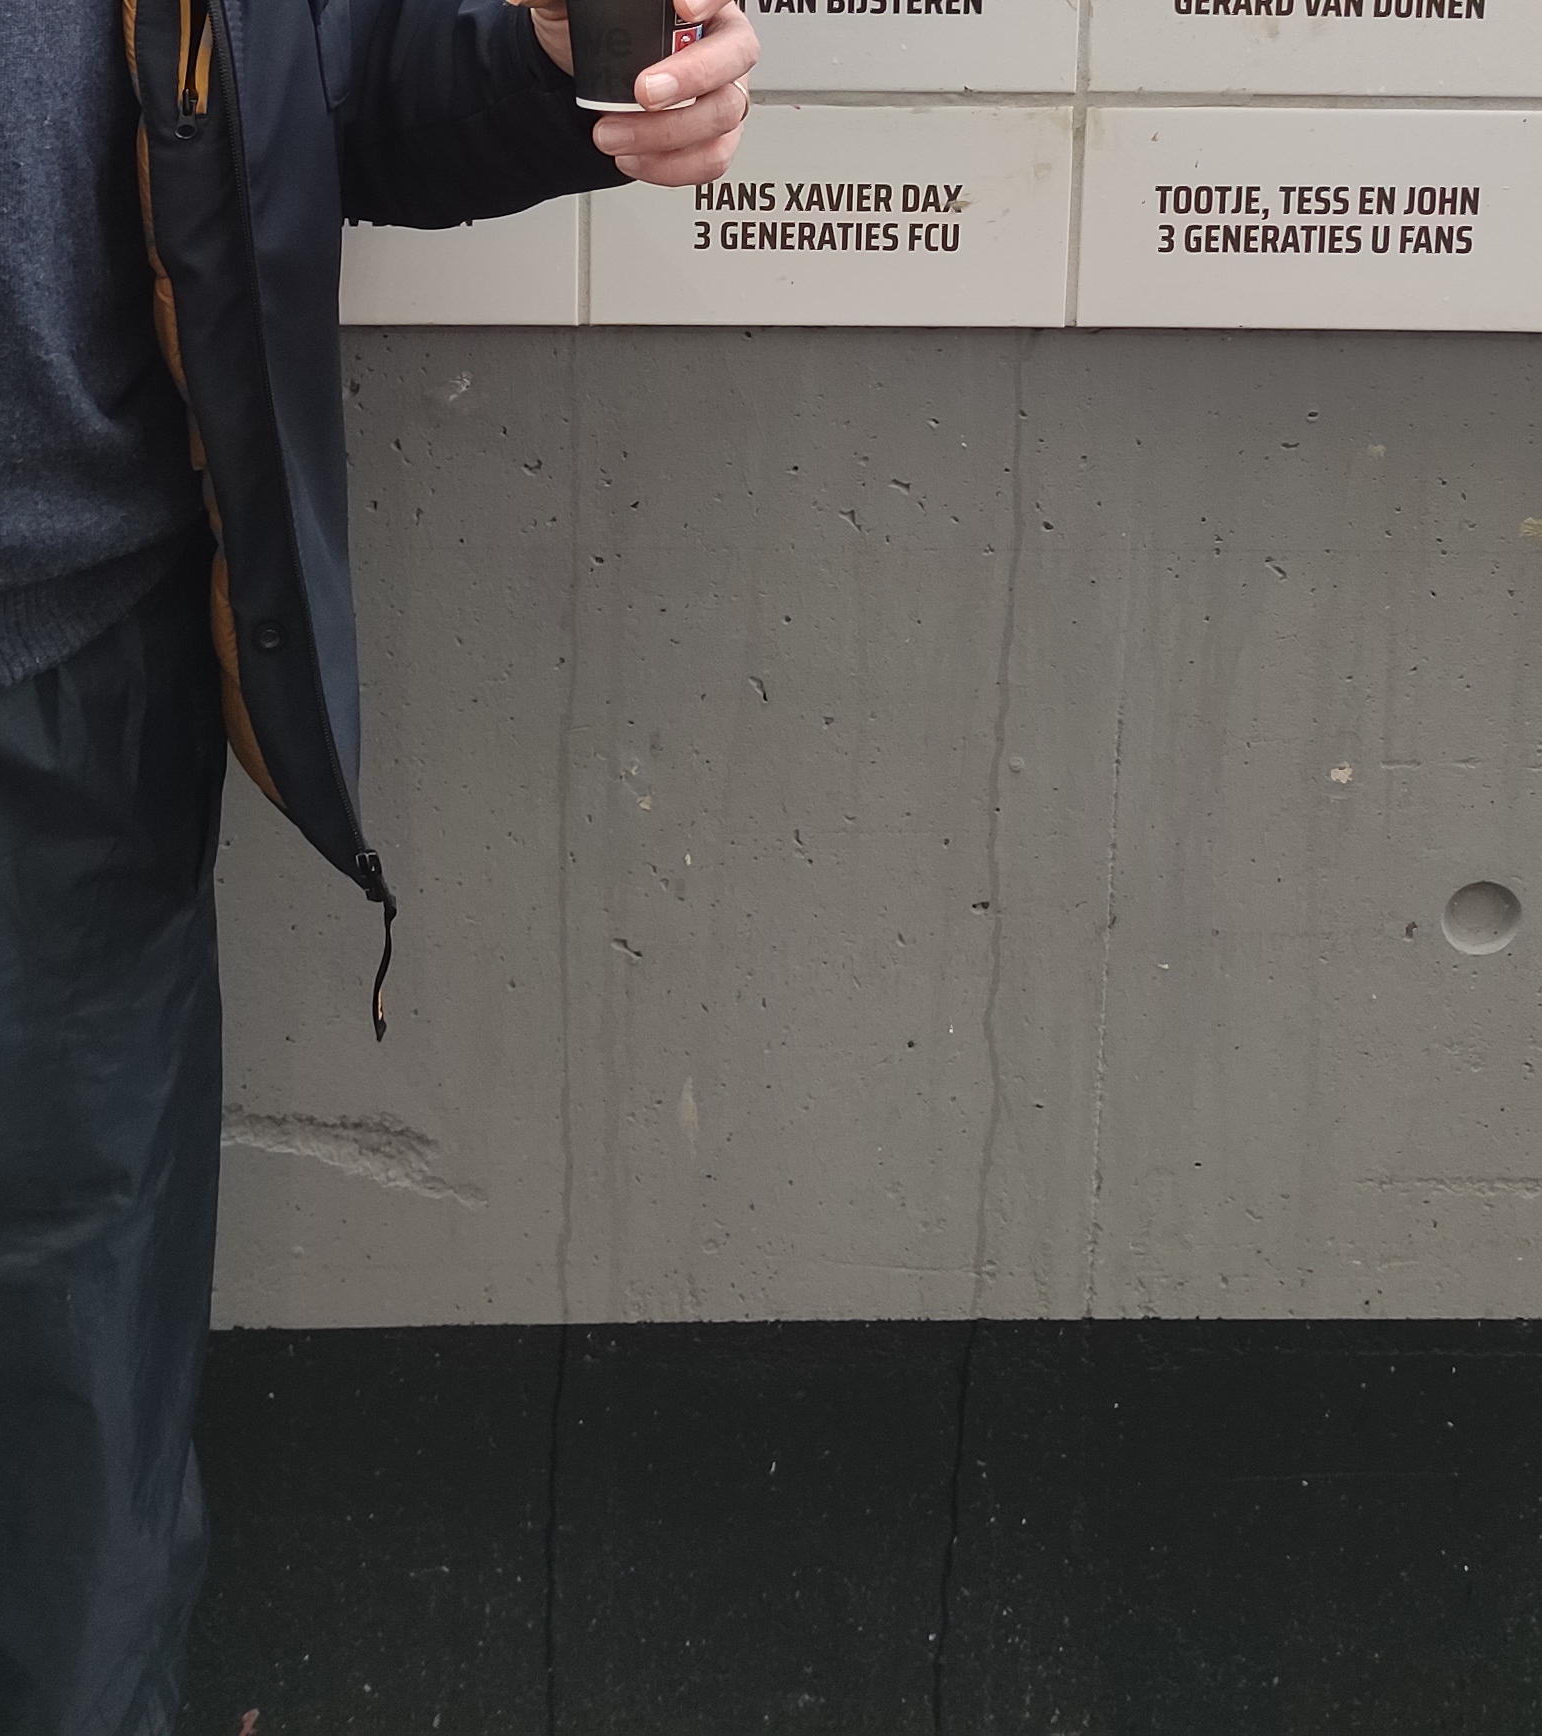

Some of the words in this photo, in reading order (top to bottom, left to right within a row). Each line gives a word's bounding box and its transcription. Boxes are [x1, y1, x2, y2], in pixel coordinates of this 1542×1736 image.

[692, 181, 776, 213] HANS
[783, 182, 893, 213] XAVIER
[901, 184, 964, 214] DAX
[1154, 185, 1270, 221] TOOTJE,
[1278, 186, 1350, 215] TESS
[1358, 186, 1396, 215] EN
[1403, 186, 1480, 216] JOHN
[693, 221, 711, 250] 3
[720, 221, 899, 252] GENERATIES
[908, 223, 960, 252] FCU
[1157, 224, 1175, 253] 3
[1184, 224, 1362, 254] GENERATIES
[1371, 225, 1391, 254] U
[1399, 225, 1473, 255] FANS
